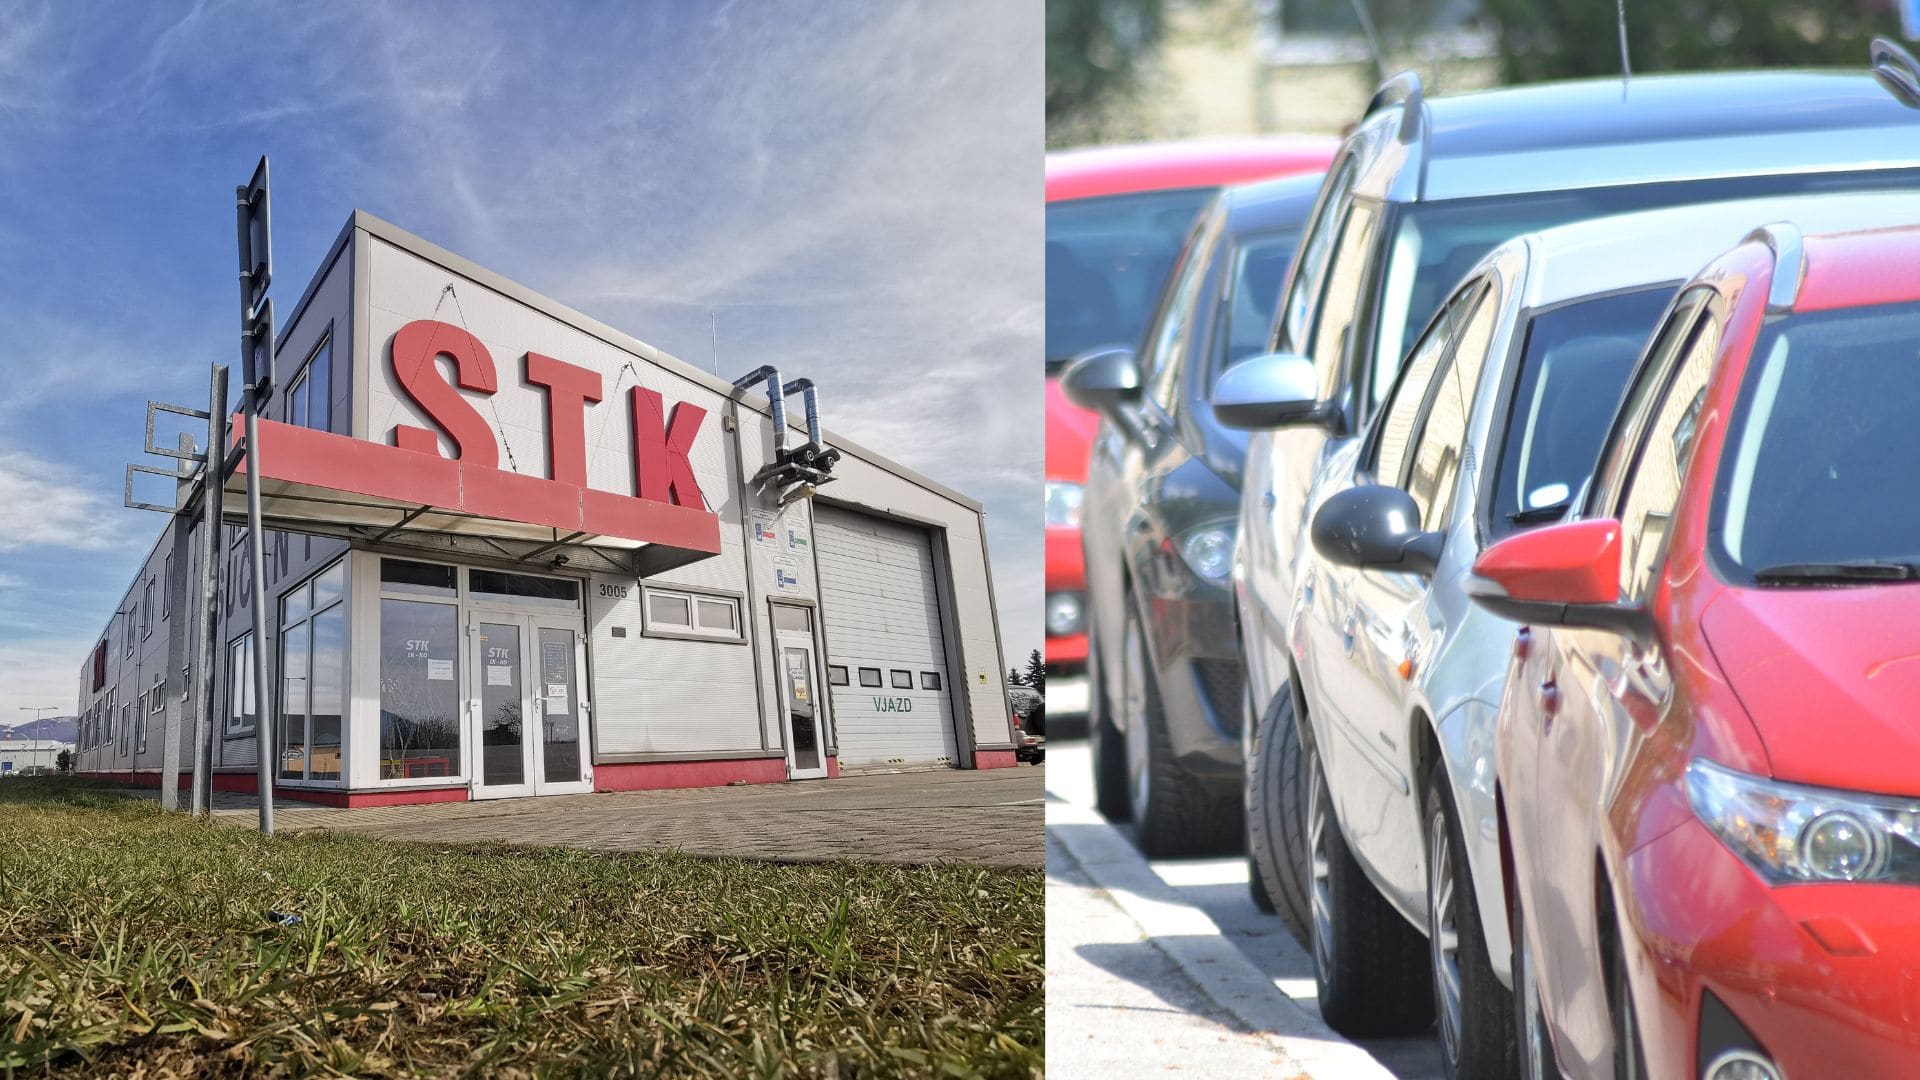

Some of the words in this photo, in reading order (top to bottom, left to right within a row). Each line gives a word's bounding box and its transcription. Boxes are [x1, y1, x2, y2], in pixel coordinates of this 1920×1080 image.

[391, 320, 707, 512] STK
[600, 584, 627, 598] 3005
[406, 640, 429, 651] STK
[488, 648, 509, 659] STK
[873, 697, 912, 713] VJAZD
